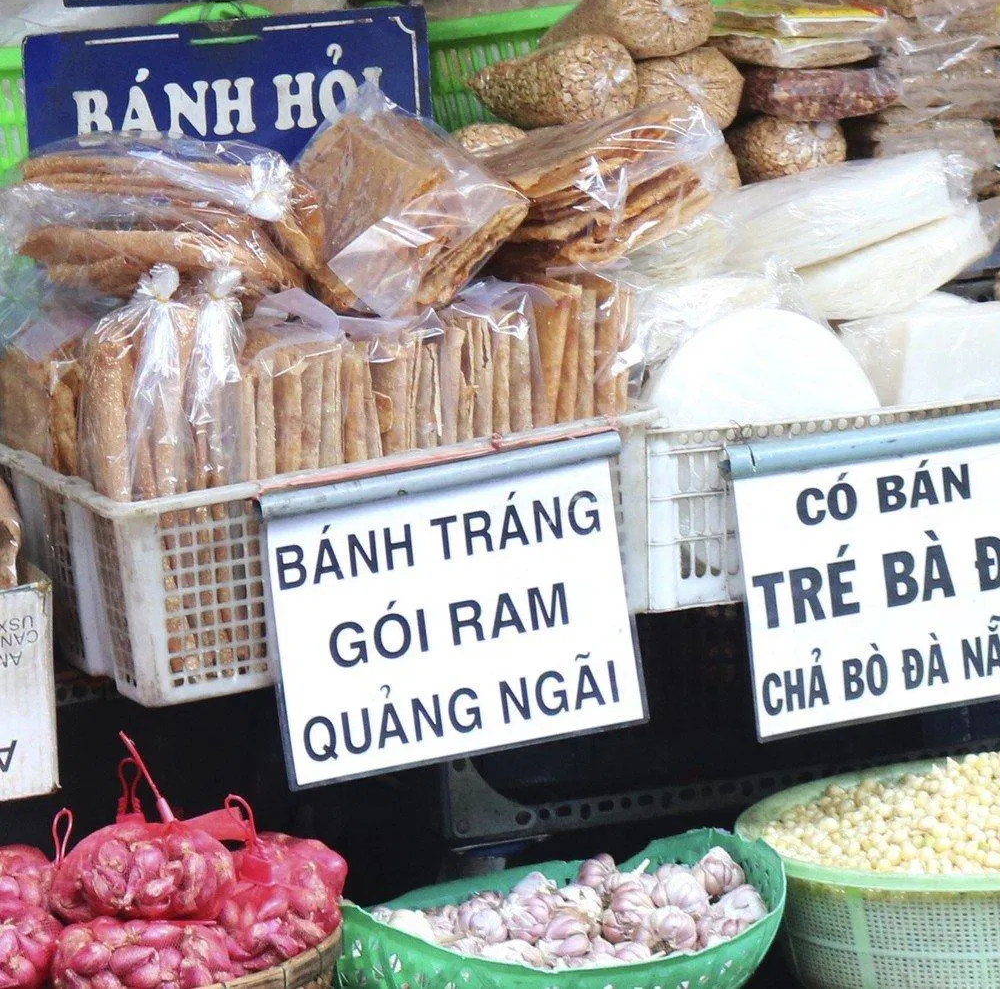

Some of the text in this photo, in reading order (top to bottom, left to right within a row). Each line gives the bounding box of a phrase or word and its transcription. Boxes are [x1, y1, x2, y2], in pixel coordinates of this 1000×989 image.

[72, 67, 256, 147] BÁNH
[796, 459, 972, 526] CÓ BÁN
[276, 491, 601, 591] BÁNH TRÁNG
[752, 543, 861, 629] TRÉ
[882, 529, 956, 608] BÀ
[329, 582, 570, 668] GÓI RAM
[303, 652, 620, 762] QUẢNG NGÃI
[761, 647, 830, 716] CHẢ
[842, 642, 888, 701] BÒ
[902, 632, 949, 690] ĐÀ
